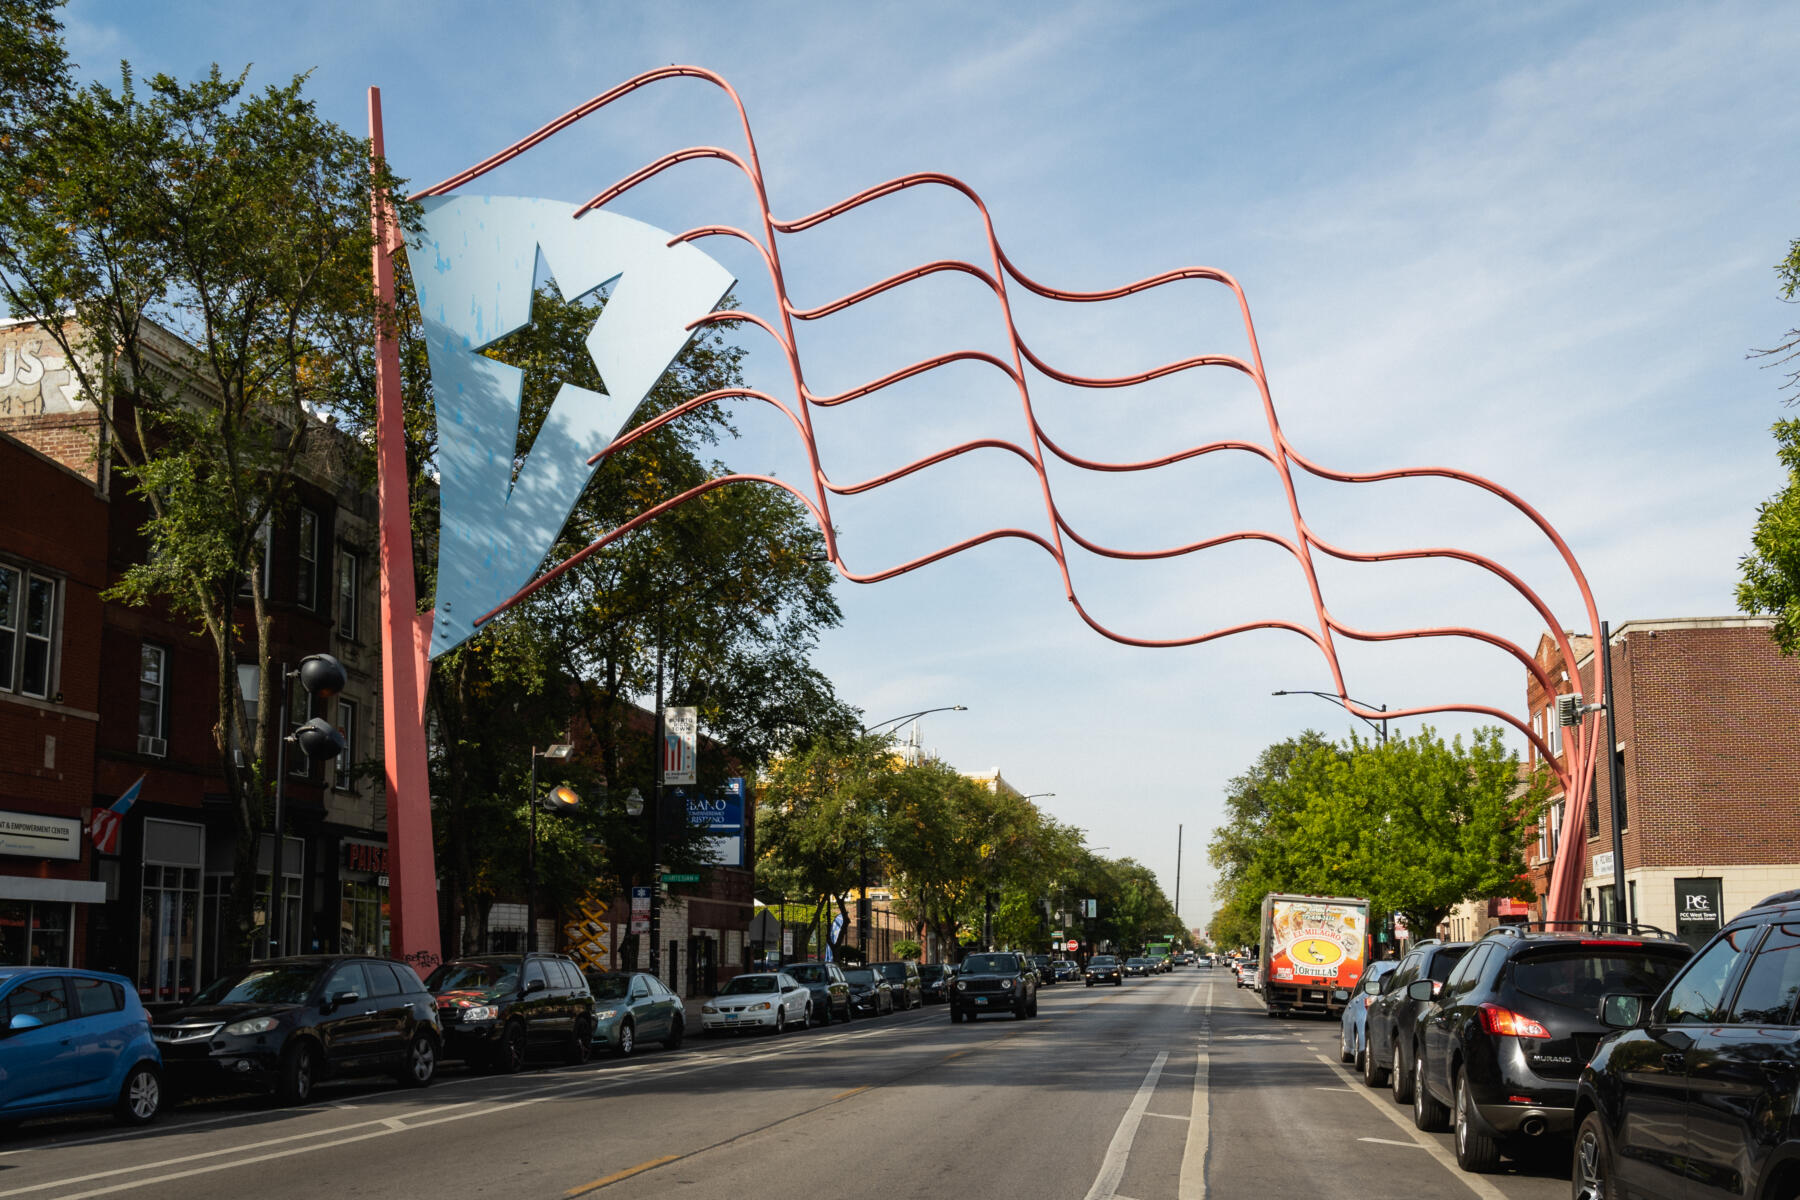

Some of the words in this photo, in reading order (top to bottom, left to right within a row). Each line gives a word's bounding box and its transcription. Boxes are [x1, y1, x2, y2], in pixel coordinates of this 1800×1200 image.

[11, 822, 50, 832] EMPOWERMENT
[51, 826, 70, 835] CENTER
[1293, 930, 1304, 938] EL
[1304, 927, 1342, 940] MILAGRO
[1294, 963, 1338, 977] TORTILLAS
[1533, 1055, 1572, 1063] MURANO
